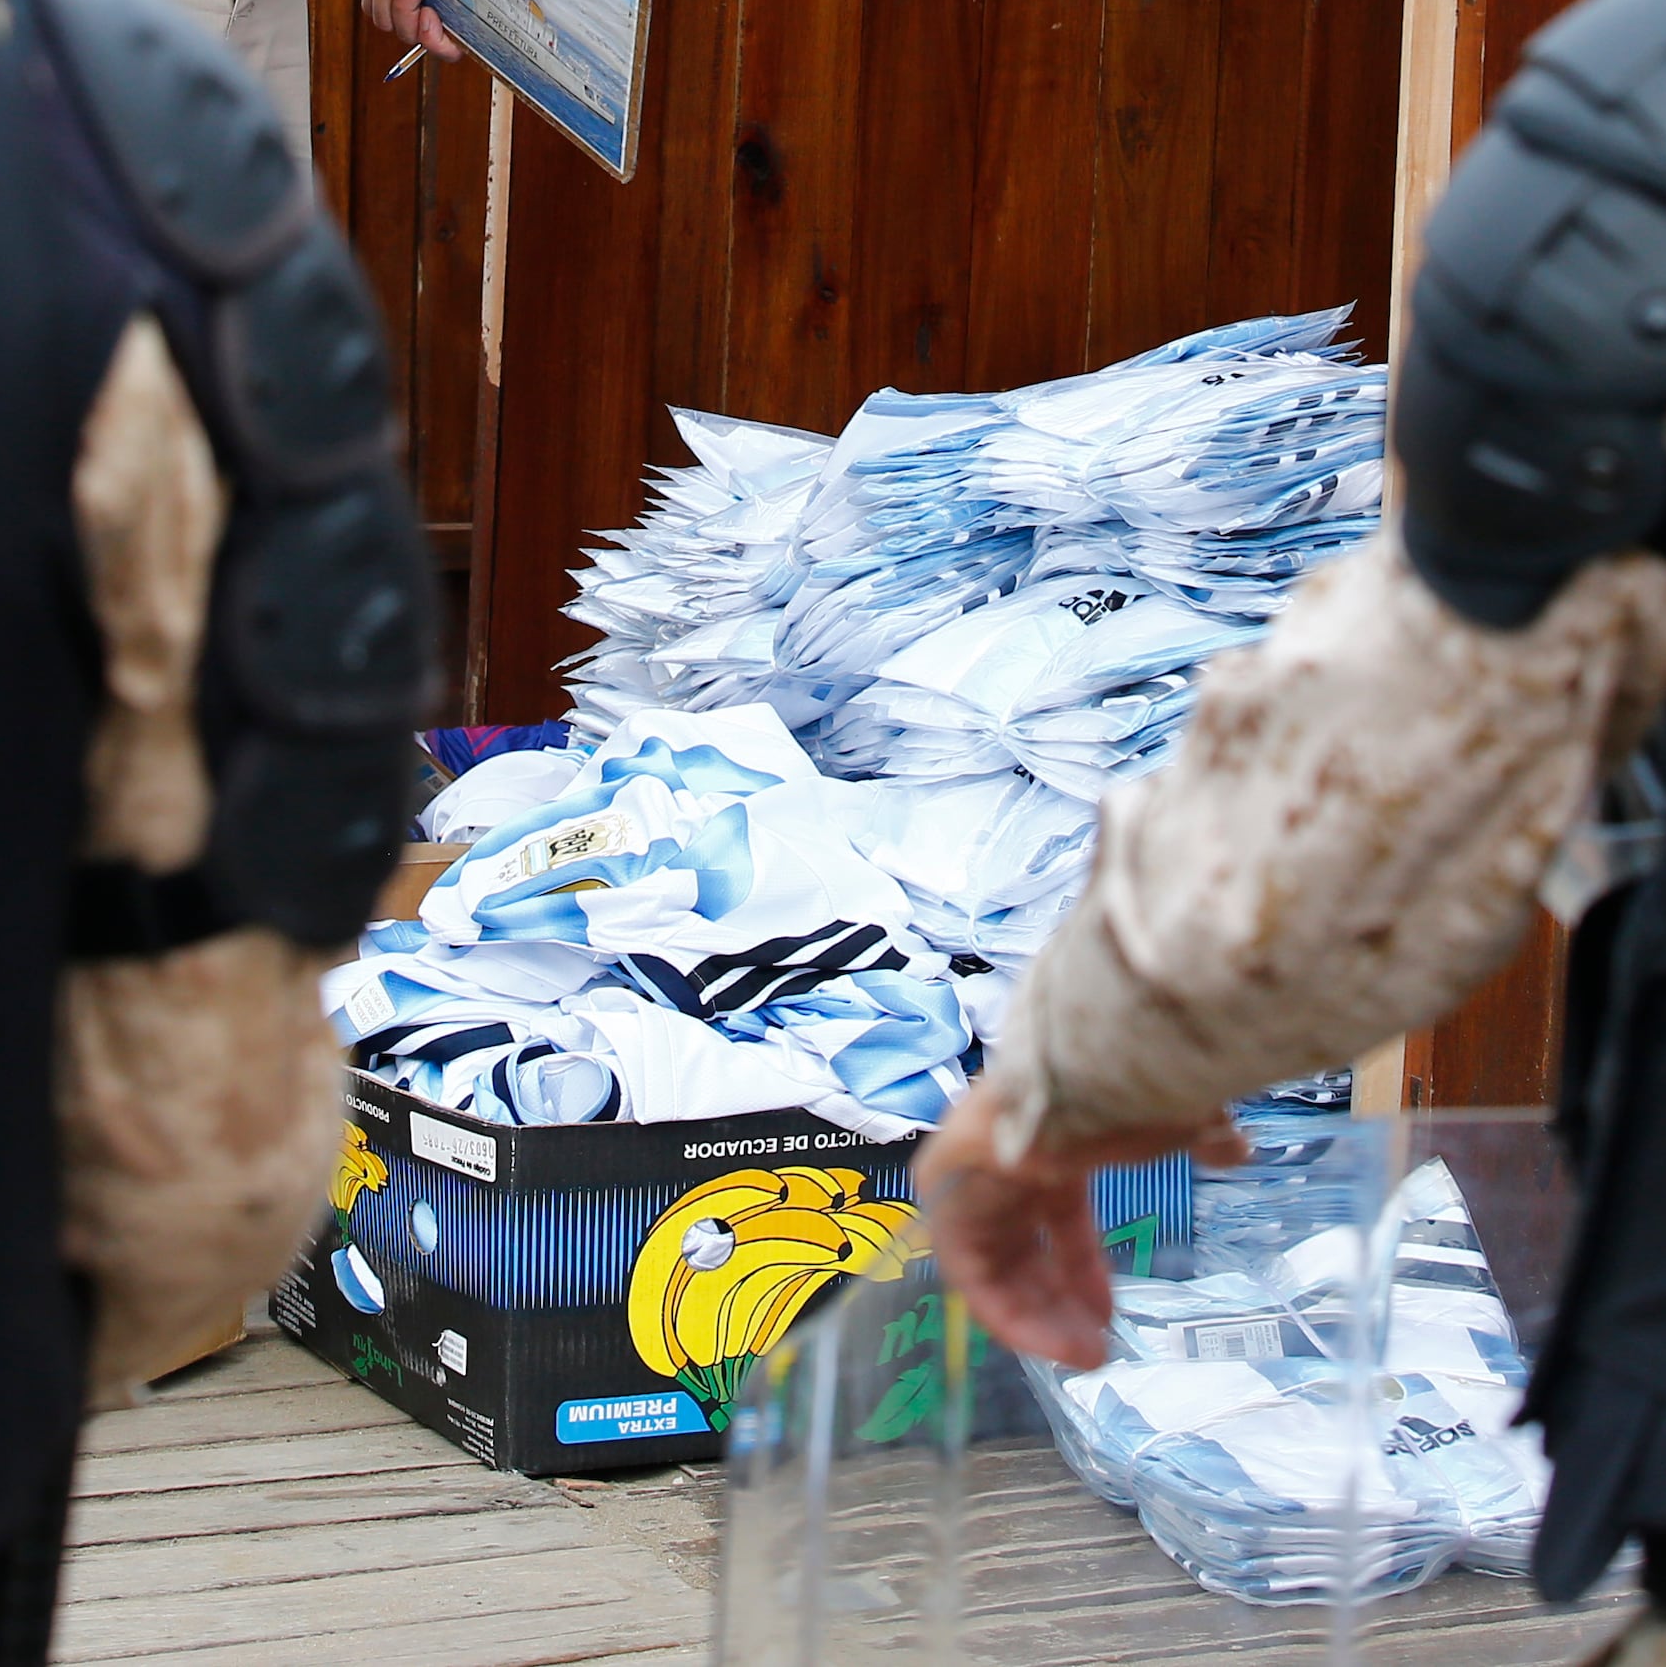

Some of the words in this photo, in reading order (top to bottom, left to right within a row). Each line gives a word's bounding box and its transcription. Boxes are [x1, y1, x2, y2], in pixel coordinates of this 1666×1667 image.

[486, 10, 539, 62] PREFECTURA
[346, 1094, 390, 1124] PRODUCTO
[683, 1138, 778, 1160] ECUADOR
[783, 1134, 809, 1152] DE
[814, 1129, 917, 1150] PUCTO
[567, 1397, 678, 1423] PREMIUM
[617, 1416, 677, 1435] EXTRA
[1382, 1421, 1476, 1457] addas
